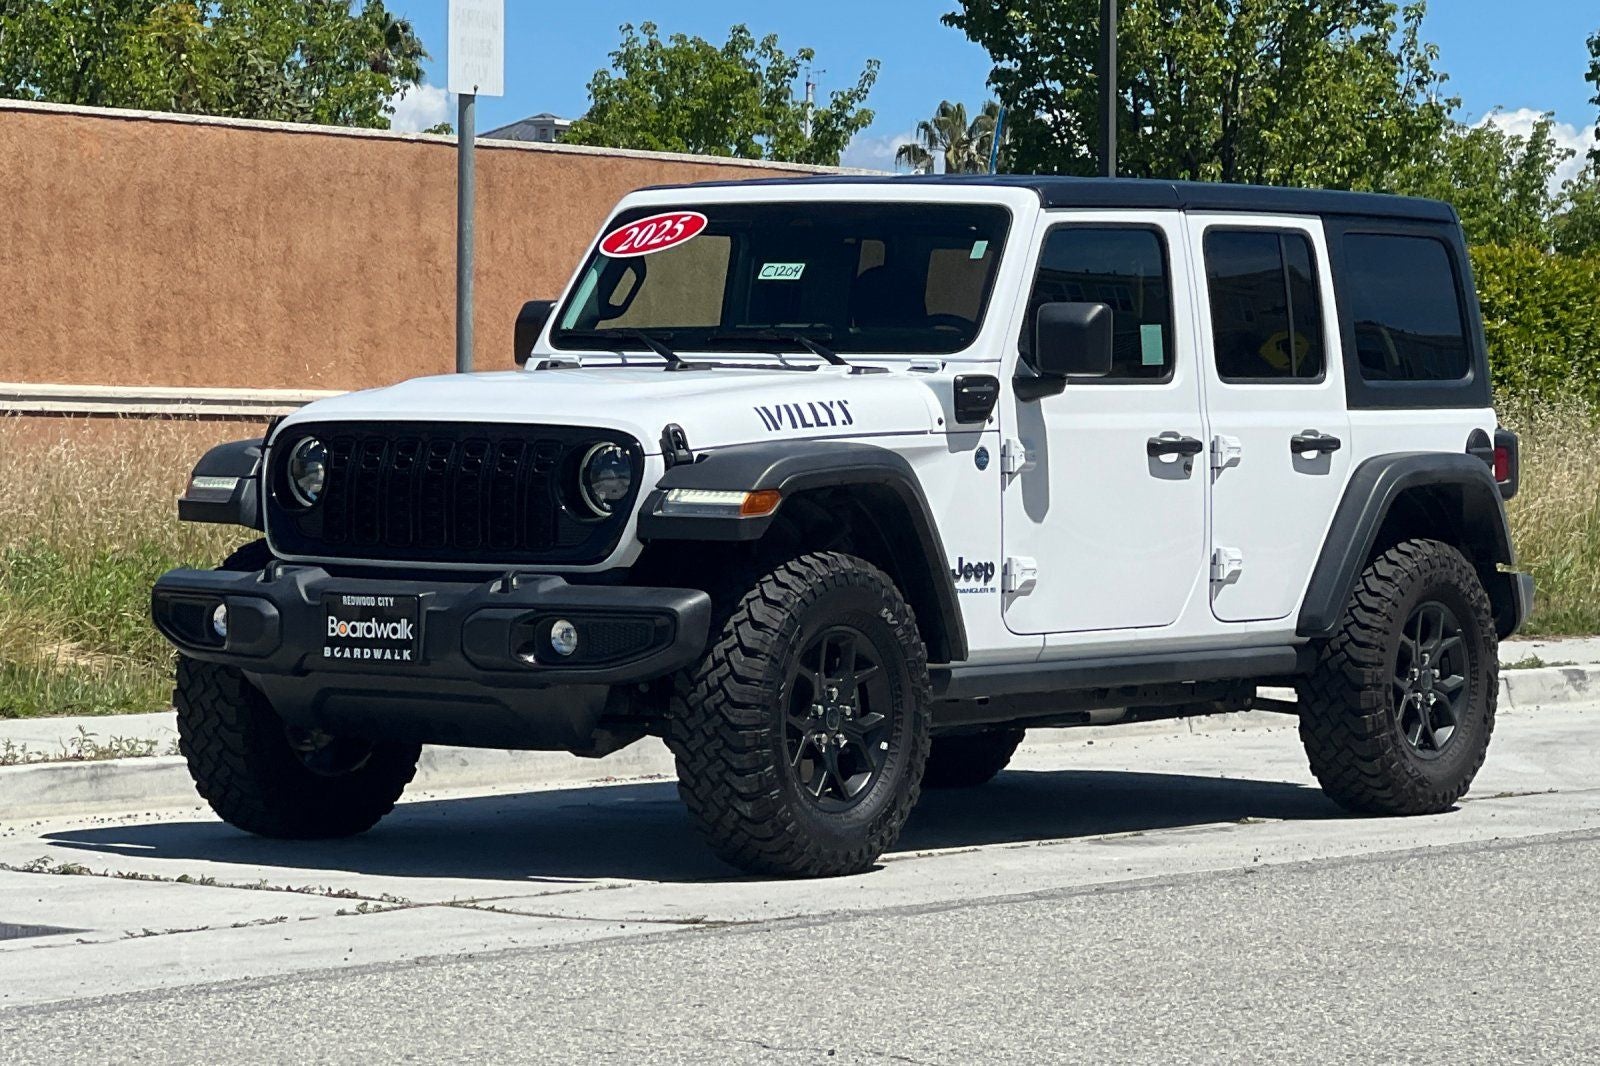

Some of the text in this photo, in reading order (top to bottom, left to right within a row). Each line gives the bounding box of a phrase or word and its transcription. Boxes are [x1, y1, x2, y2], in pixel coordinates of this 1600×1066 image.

[614, 216, 692, 253] 2025
[762, 264, 801, 277] C1204
[753, 400, 853, 431] WILLYS
[951, 557, 994, 584] Jeep
[343, 596, 394, 606] REDWOOD CITY
[327, 616, 413, 640] Boardwalk
[324, 646, 411, 660] BOARDWALK
